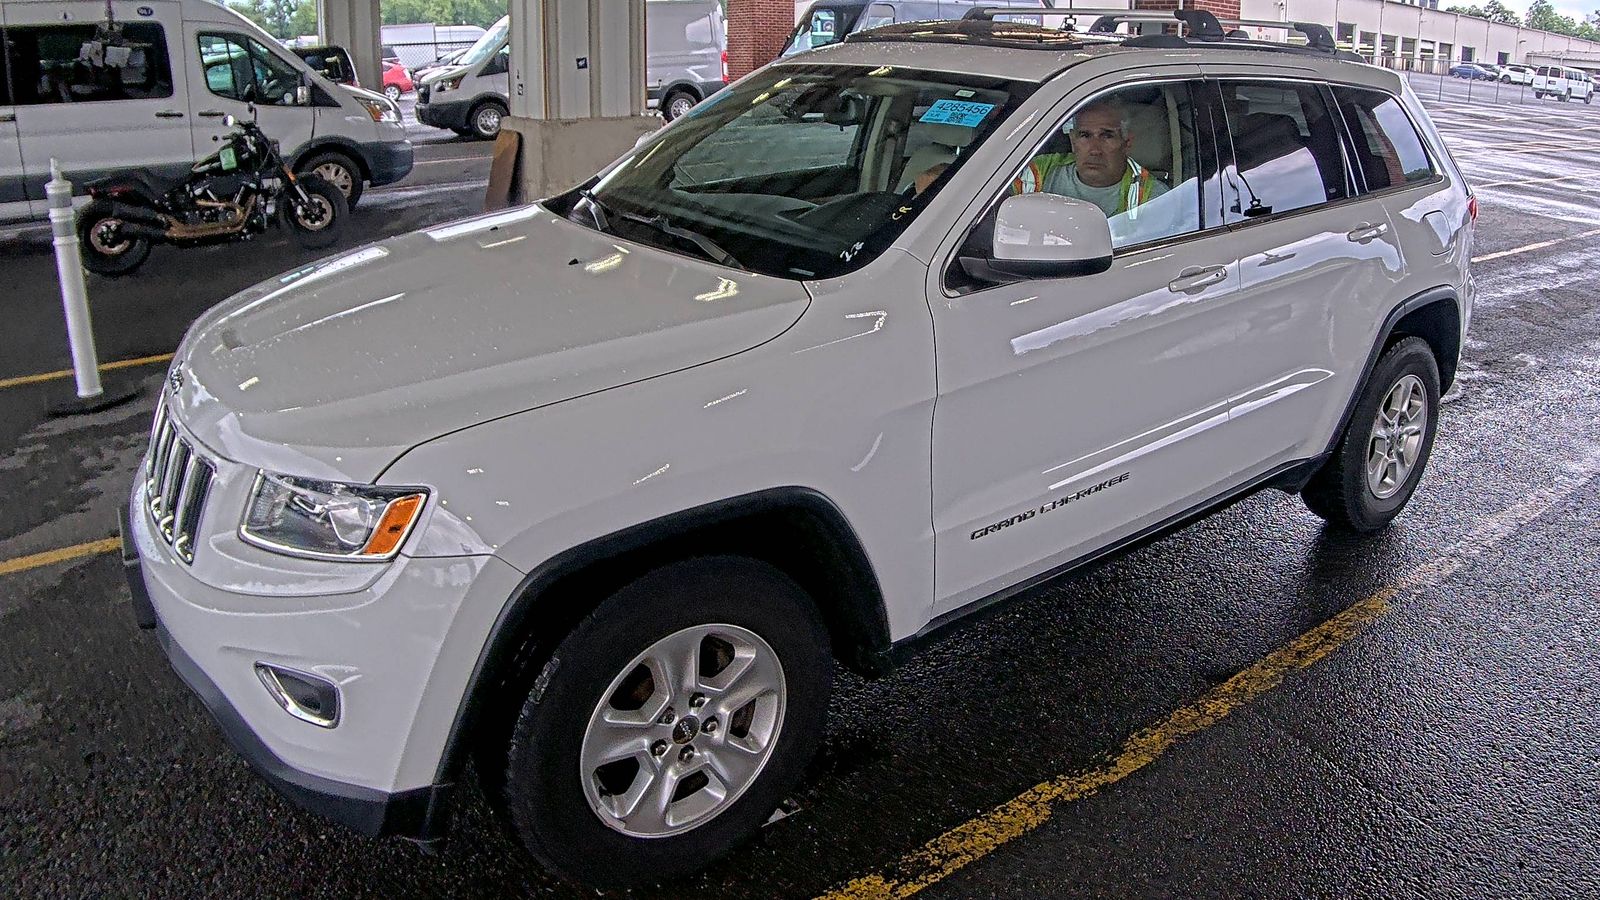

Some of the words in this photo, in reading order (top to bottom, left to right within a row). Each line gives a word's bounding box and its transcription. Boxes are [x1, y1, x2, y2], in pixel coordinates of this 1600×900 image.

[937, 102, 990, 115] 4285456
[892, 206, 912, 220] CR
[970, 508, 1036, 541] GRAND
[1039, 471, 1130, 514] CHEROKEE
